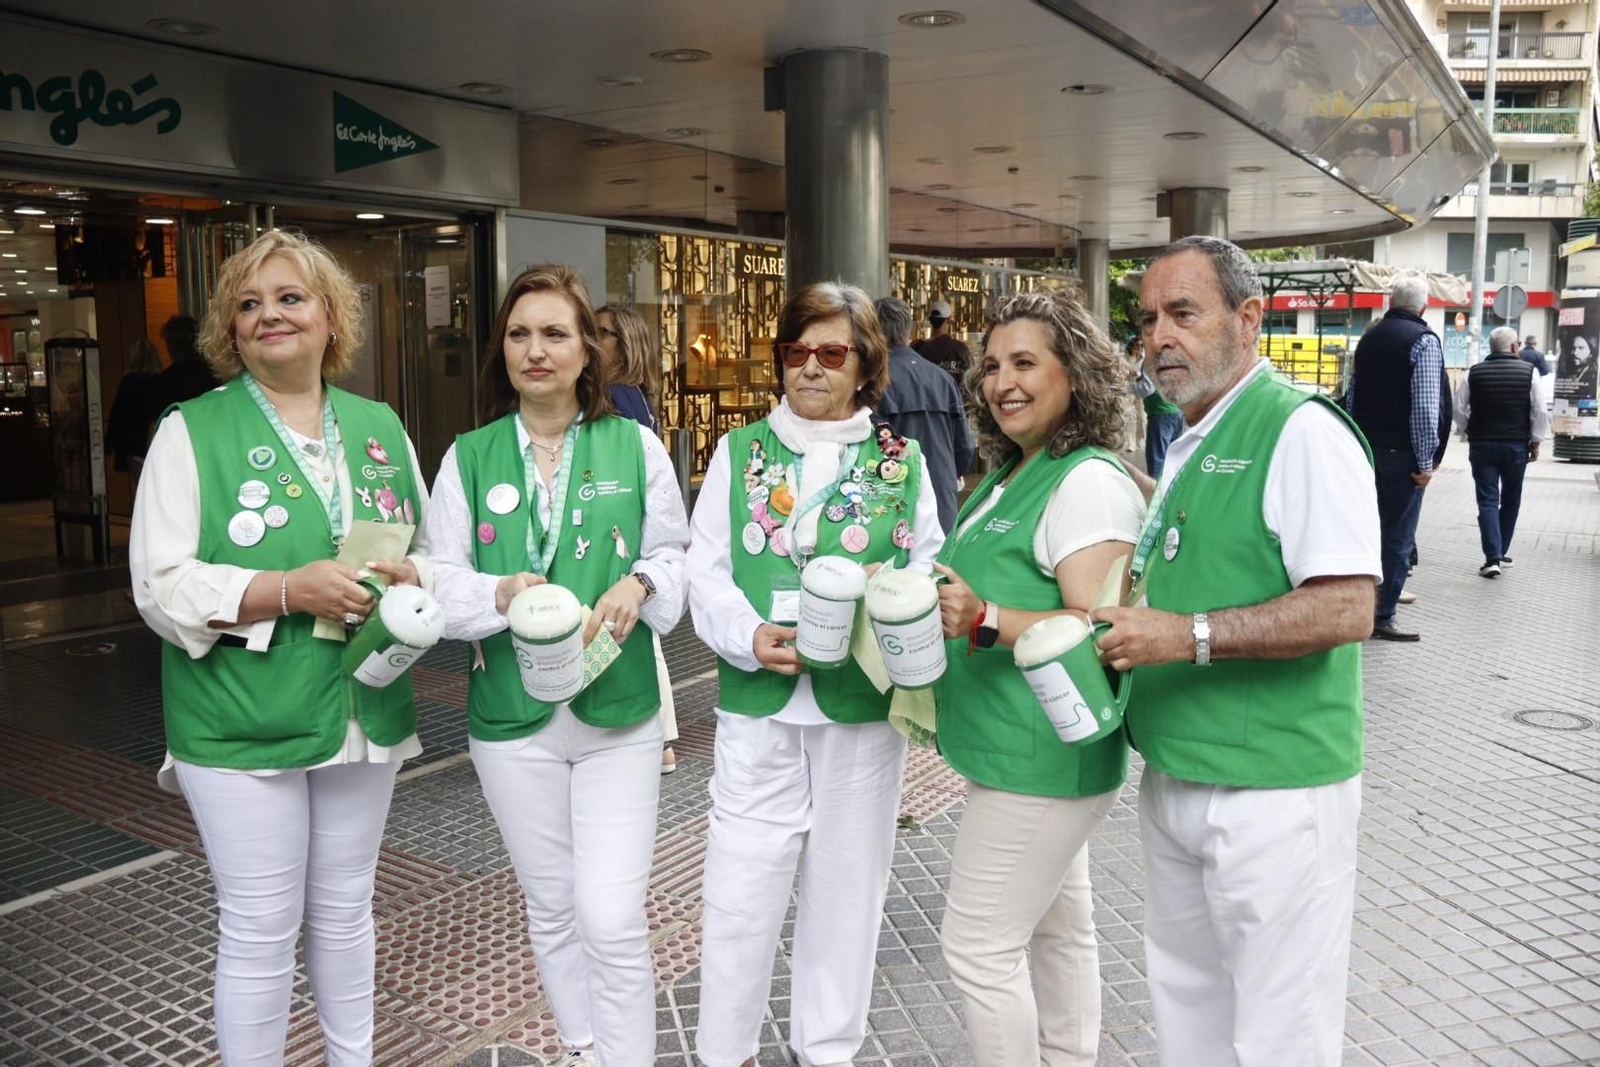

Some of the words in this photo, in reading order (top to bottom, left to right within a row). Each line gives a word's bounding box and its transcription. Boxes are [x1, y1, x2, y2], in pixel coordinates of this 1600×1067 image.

[0, 69, 182, 146] nglés
[336, 123, 349, 140] El
[349, 126, 377, 144] Corte
[378, 125, 416, 152] Inglés
[743, 254, 786, 276] SUARE
[947, 276, 979, 293] SUAREZ
